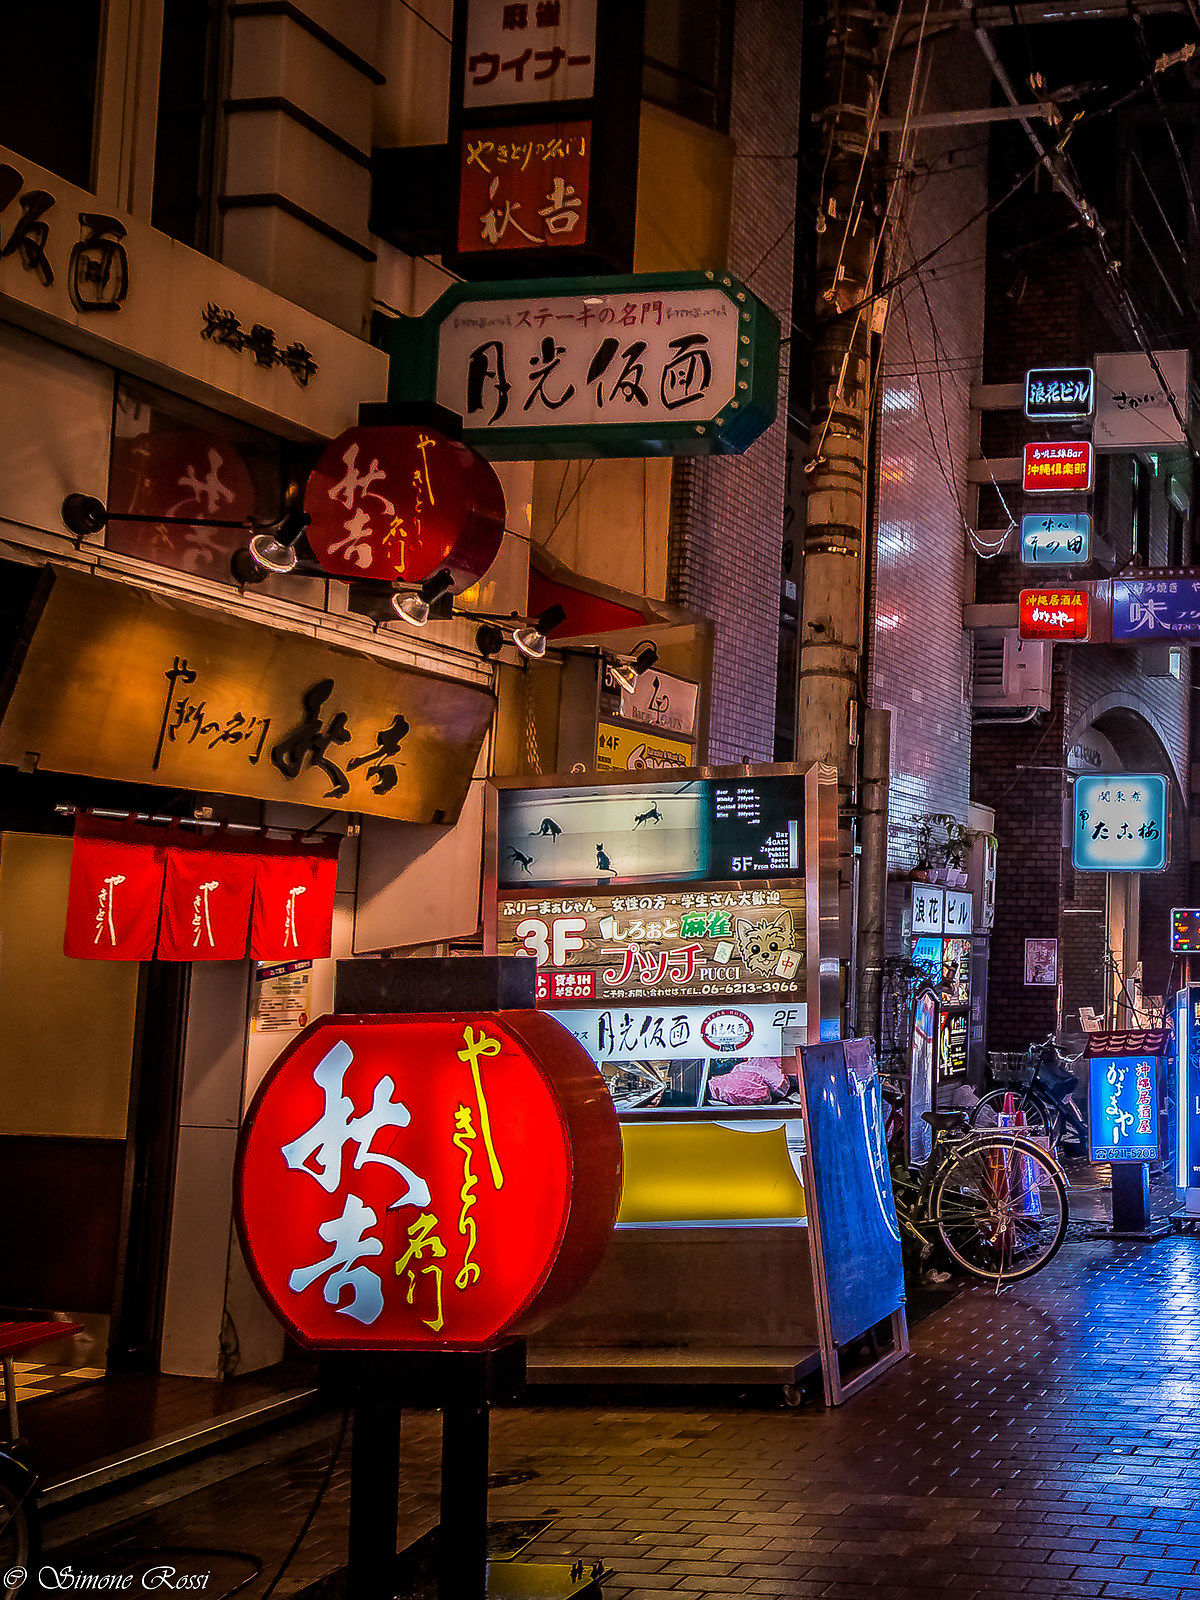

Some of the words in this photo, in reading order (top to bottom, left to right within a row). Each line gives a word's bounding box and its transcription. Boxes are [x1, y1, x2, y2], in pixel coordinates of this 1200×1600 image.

[468, 46, 592, 87] ウイナー
[481, 176, 584, 246] 秋吉
[514, 300, 663, 328] ステーキの名門
[466, 332, 712, 426] 月光仮面
[1029, 380, 1089, 404] 浪花ビル
[1028, 463, 1087, 476] 沖縄倶楽部
[328, 443, 396, 567] 秋吉
[1025, 594, 1082, 606] 沖縄居酒屋
[731, 856, 753, 872] 5F
[503, 902, 597, 916] ふりーまぁじゃん
[611, 891, 781, 911] 女性の方・学生さん大歓迎
[915, 896, 968, 925] 浪花ビル
[514, 917, 587, 968] 3F
[601, 942, 708, 986] プッチ
[700, 966, 740, 981] PUCCI
[772, 1009, 798, 1027] 2F
[597, 1011, 690, 1057] 月光仮面
[1135, 1062, 1153, 1134] 沖縄居酒屋
[1108, 1149, 1156, 1159] 6211-5208
[281, 1040, 432, 1325] 秋吉
